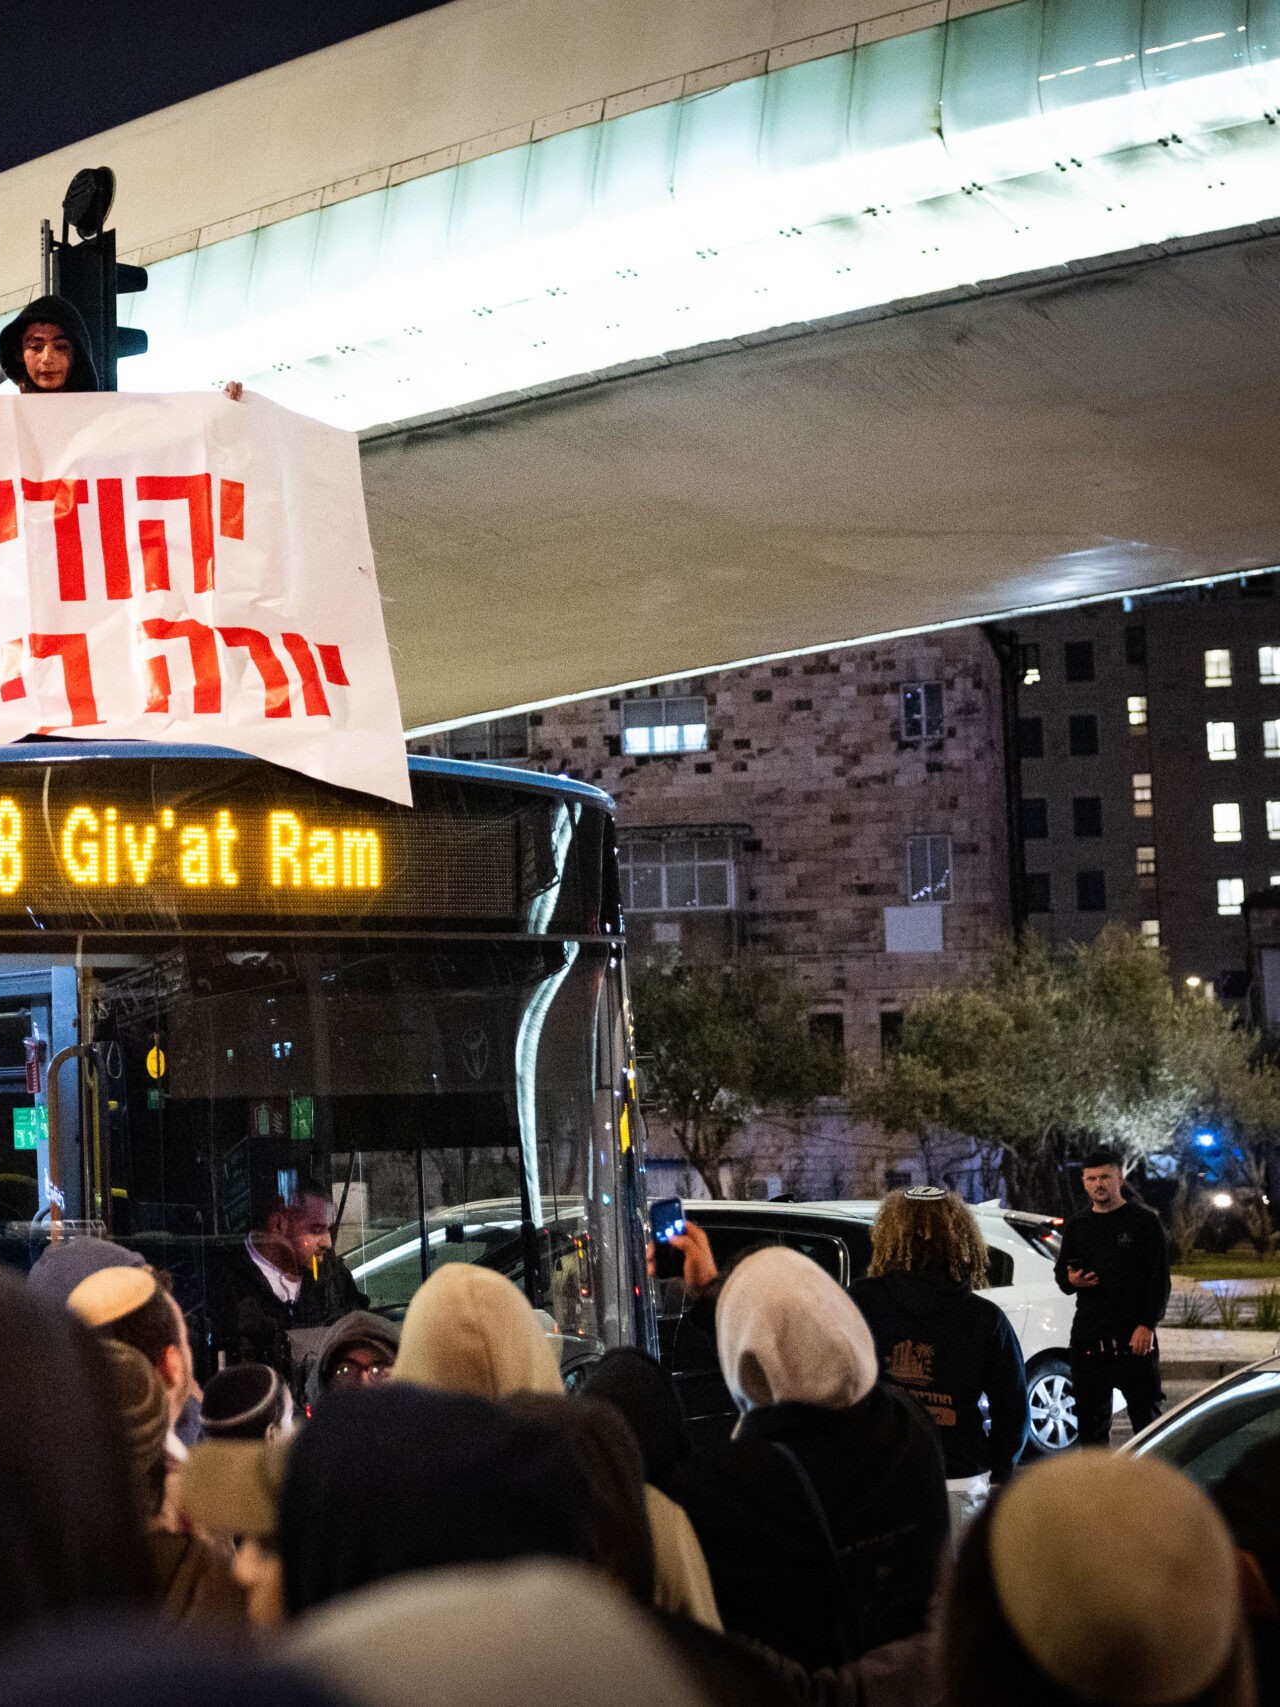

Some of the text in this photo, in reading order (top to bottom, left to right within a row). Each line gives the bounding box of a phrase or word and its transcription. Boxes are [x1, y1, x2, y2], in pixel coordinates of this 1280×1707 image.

[139, 617, 351, 719] יורה
[60, 805, 240, 887] Giv'at
[268, 808, 382, 888] Ram
